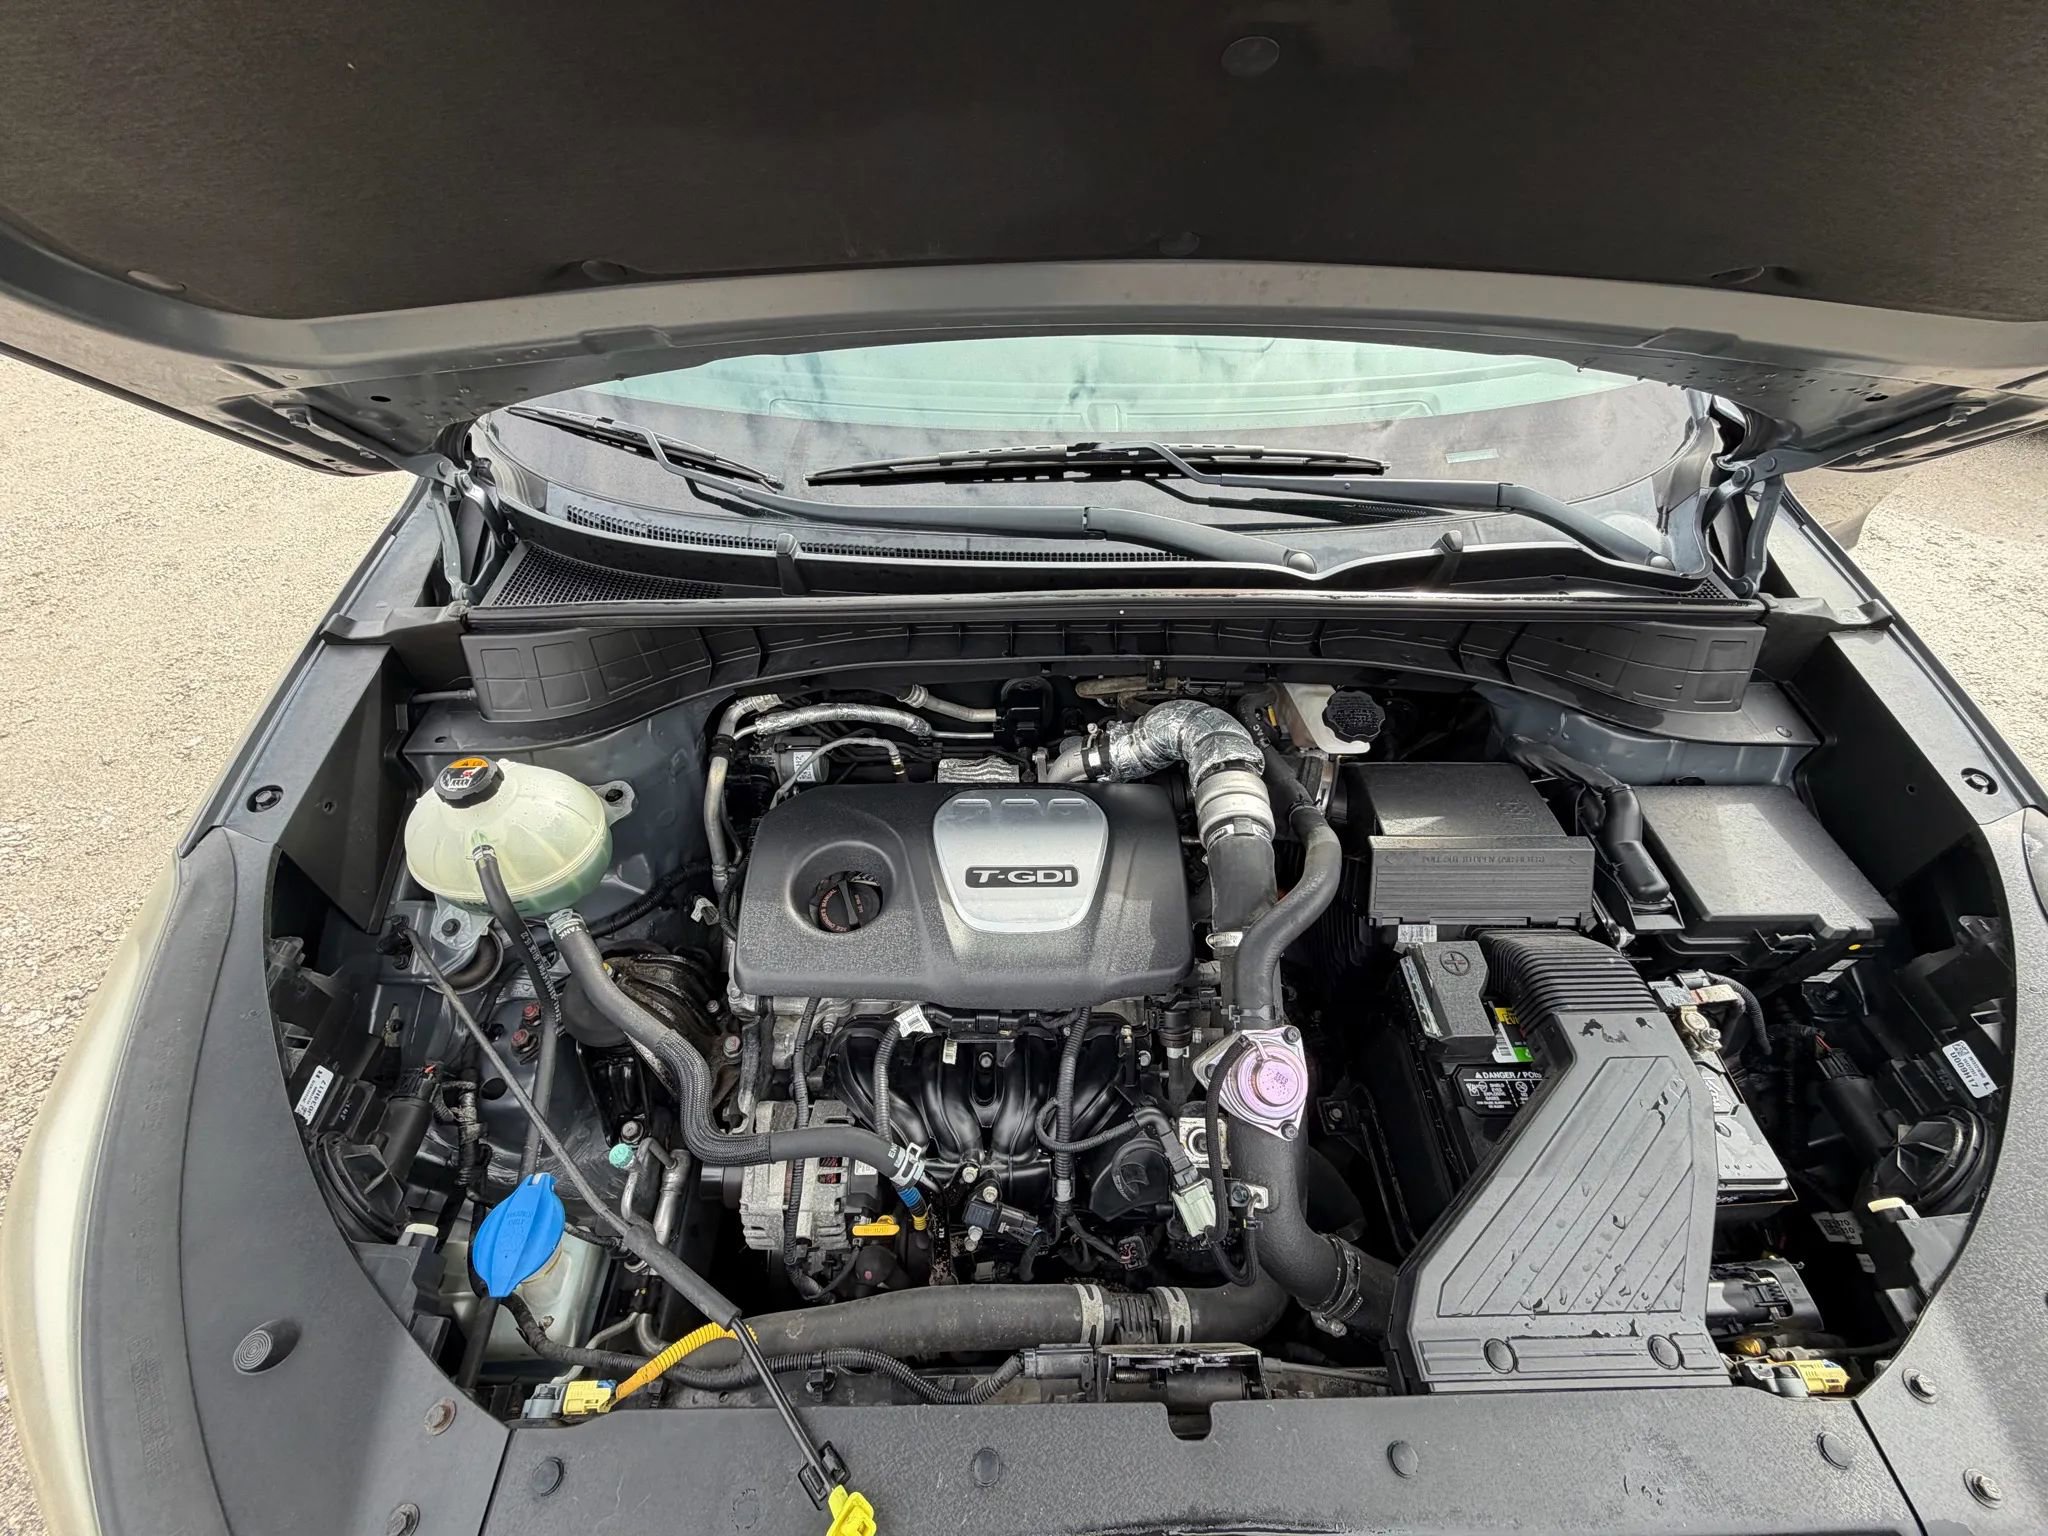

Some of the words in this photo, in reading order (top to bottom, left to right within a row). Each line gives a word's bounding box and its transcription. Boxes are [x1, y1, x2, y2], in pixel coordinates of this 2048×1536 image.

[972, 869, 1073, 883] T-GDI
[558, 925, 582, 940] TANK
[1482, 1071, 1516, 1079] DANGER
